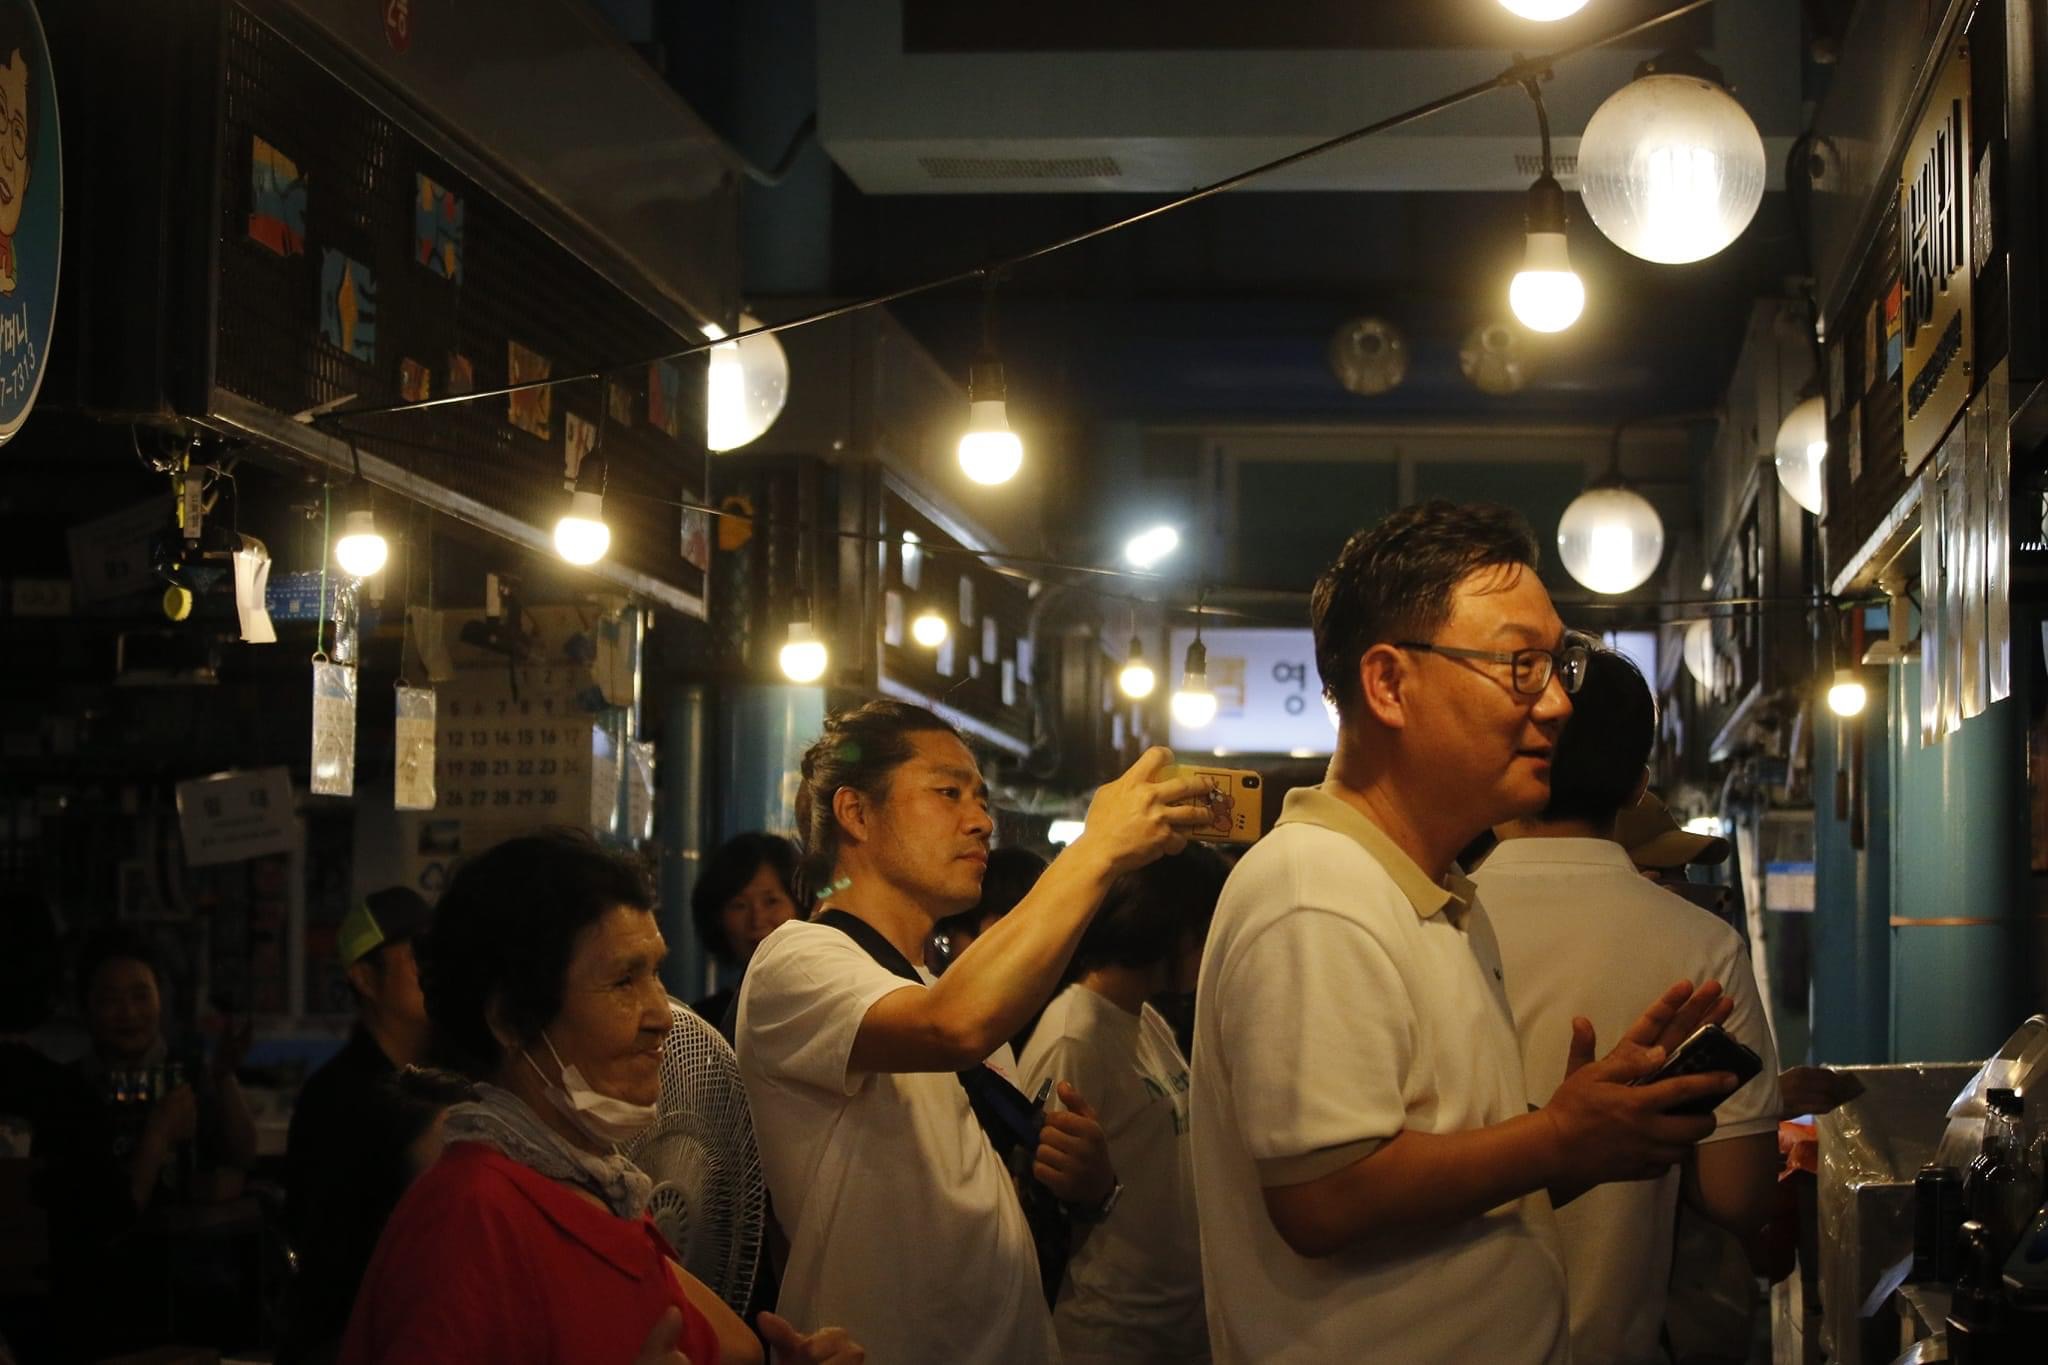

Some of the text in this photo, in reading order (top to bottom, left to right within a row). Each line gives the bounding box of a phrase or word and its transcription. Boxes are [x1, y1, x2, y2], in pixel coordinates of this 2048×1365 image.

[448, 731, 463, 746] 12
[471, 731, 487, 746] 13
[495, 730, 511, 745] 14
[518, 729, 533, 745] 15
[541, 729, 556, 745] 16
[448, 761, 463, 776] 19
[470, 761, 486, 776] 20
[493, 760, 509, 775] 21
[517, 760, 534, 775] 22
[540, 759, 556, 775] 23
[447, 789, 557, 806] 26 27 28 29 30
